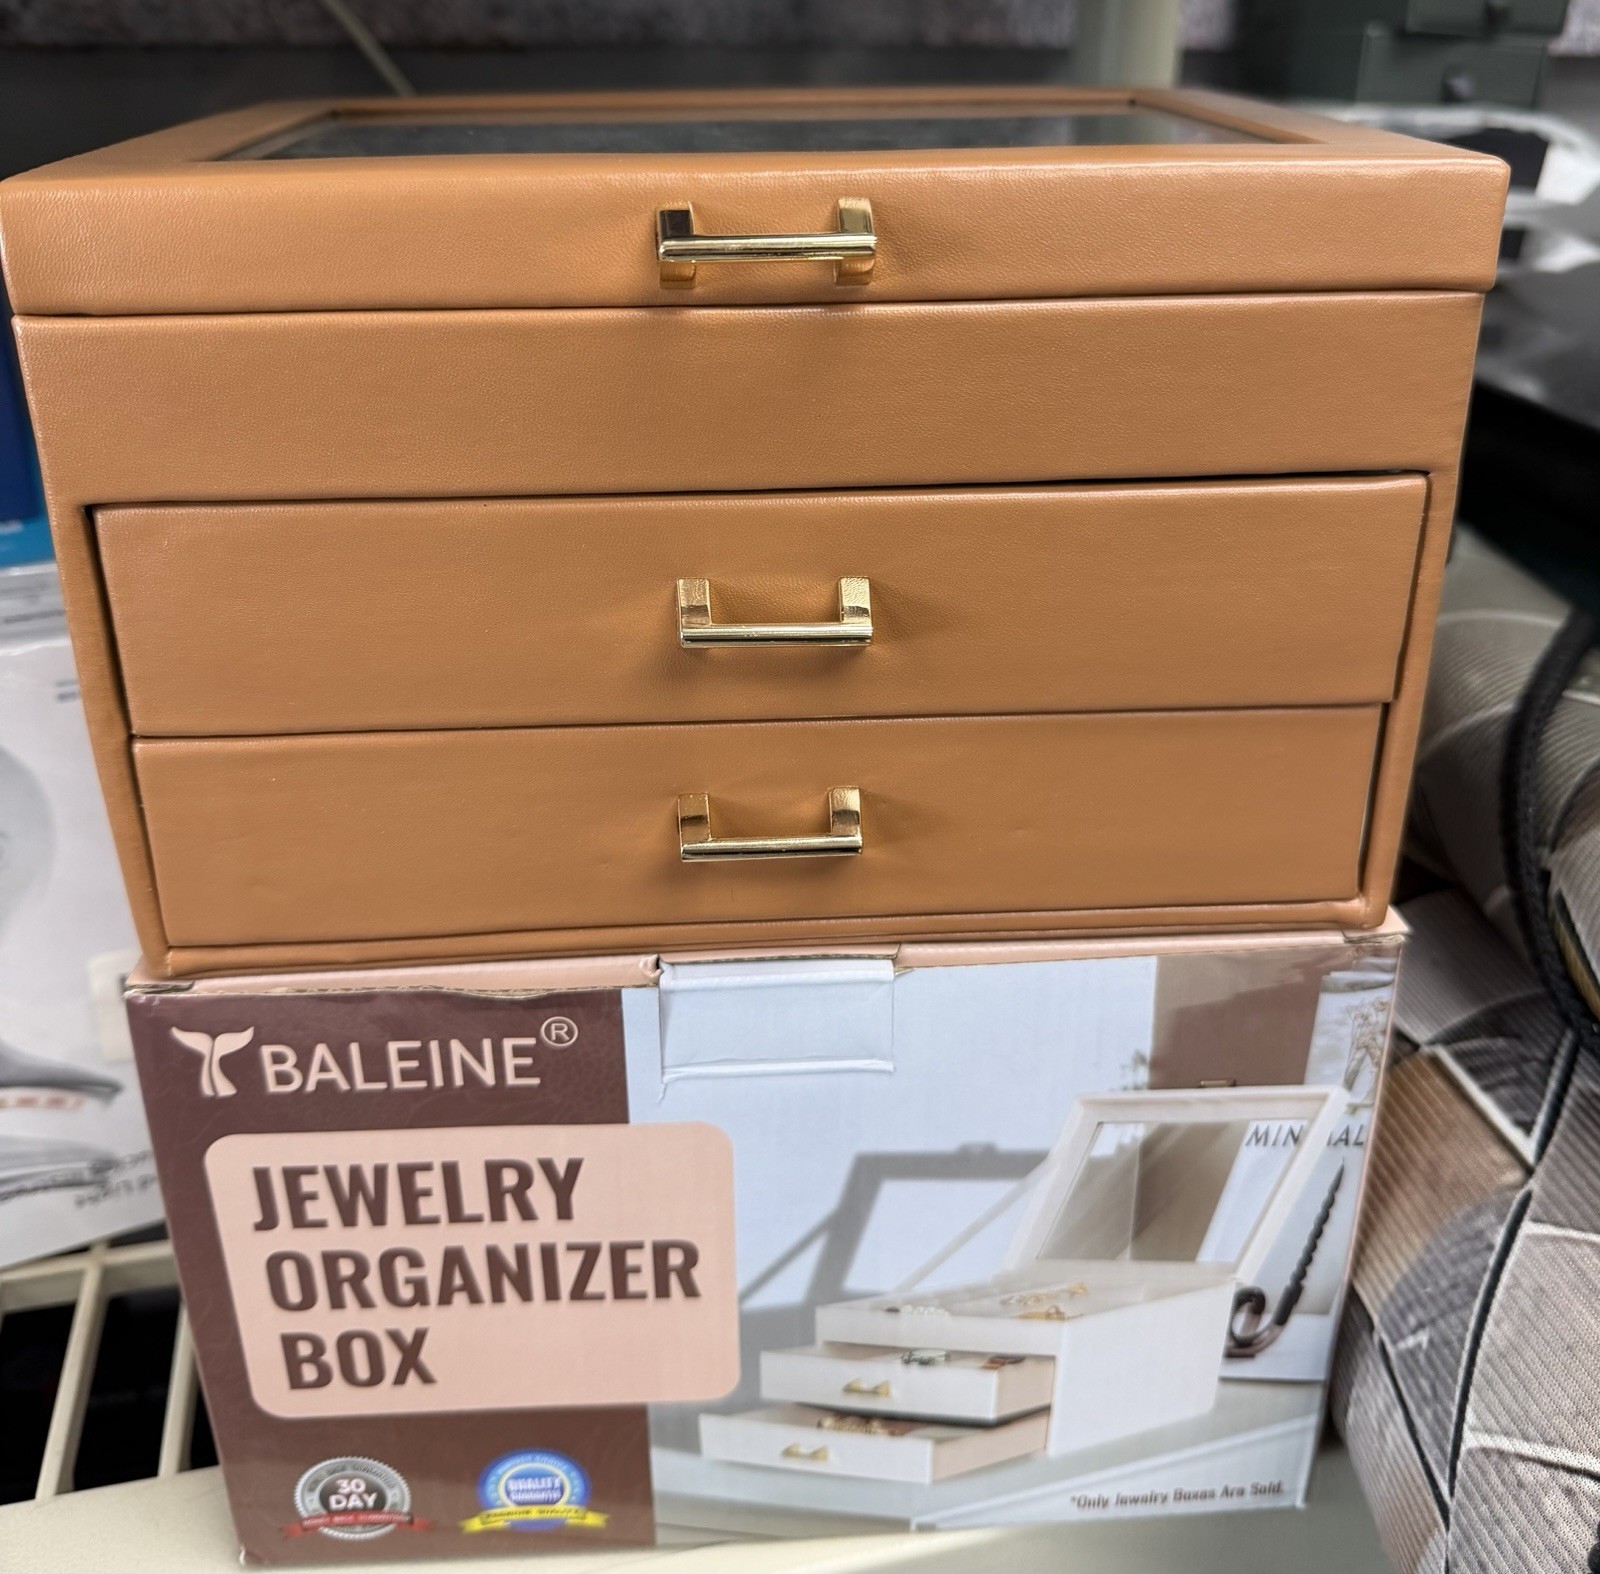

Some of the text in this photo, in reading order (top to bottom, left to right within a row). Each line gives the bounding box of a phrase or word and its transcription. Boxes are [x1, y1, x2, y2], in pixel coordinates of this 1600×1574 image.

[252, 1157, 585, 1232] JEWELRY
[265, 1239, 702, 1312] ORGANIZER
[280, 1327, 437, 1391] BOX
[328, 1492, 378, 1511] DAY
[335, 1478, 367, 1495] 30
